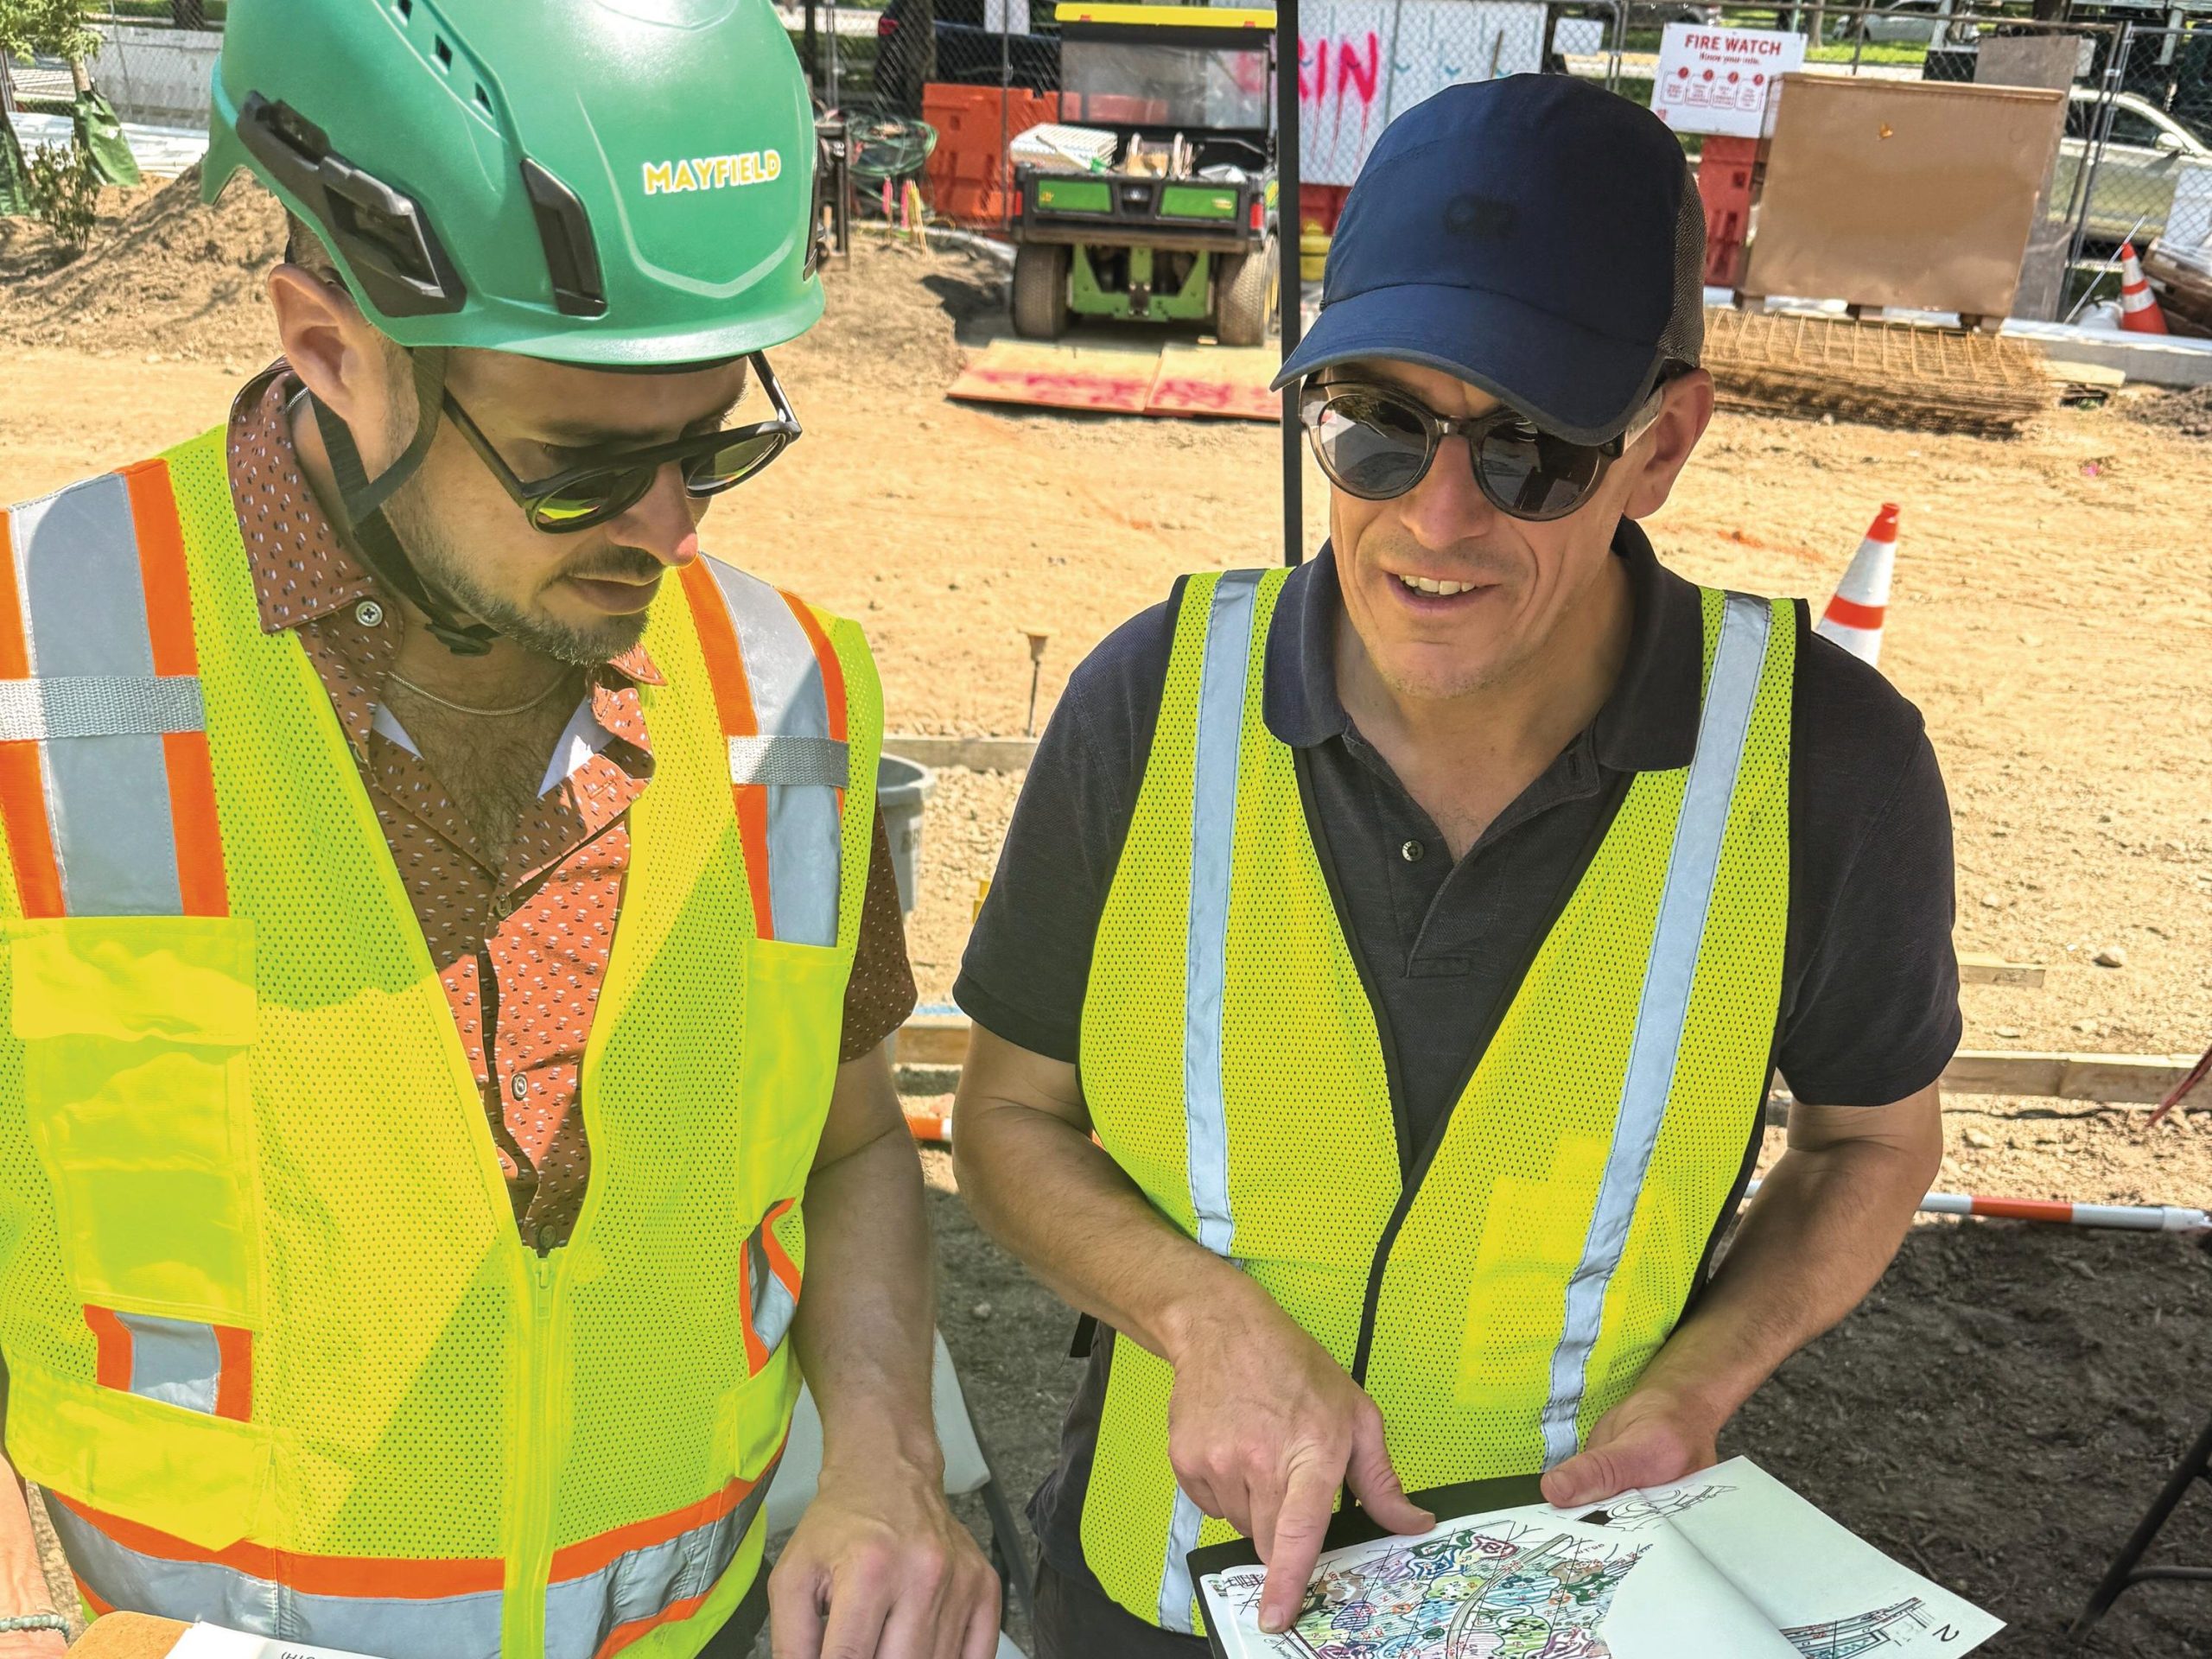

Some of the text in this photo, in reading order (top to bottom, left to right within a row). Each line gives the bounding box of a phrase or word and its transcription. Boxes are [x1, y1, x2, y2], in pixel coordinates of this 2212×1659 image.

[1685, 34, 1782, 55] FIRE WATCH
[643, 149, 781, 194] MAYFIELD
